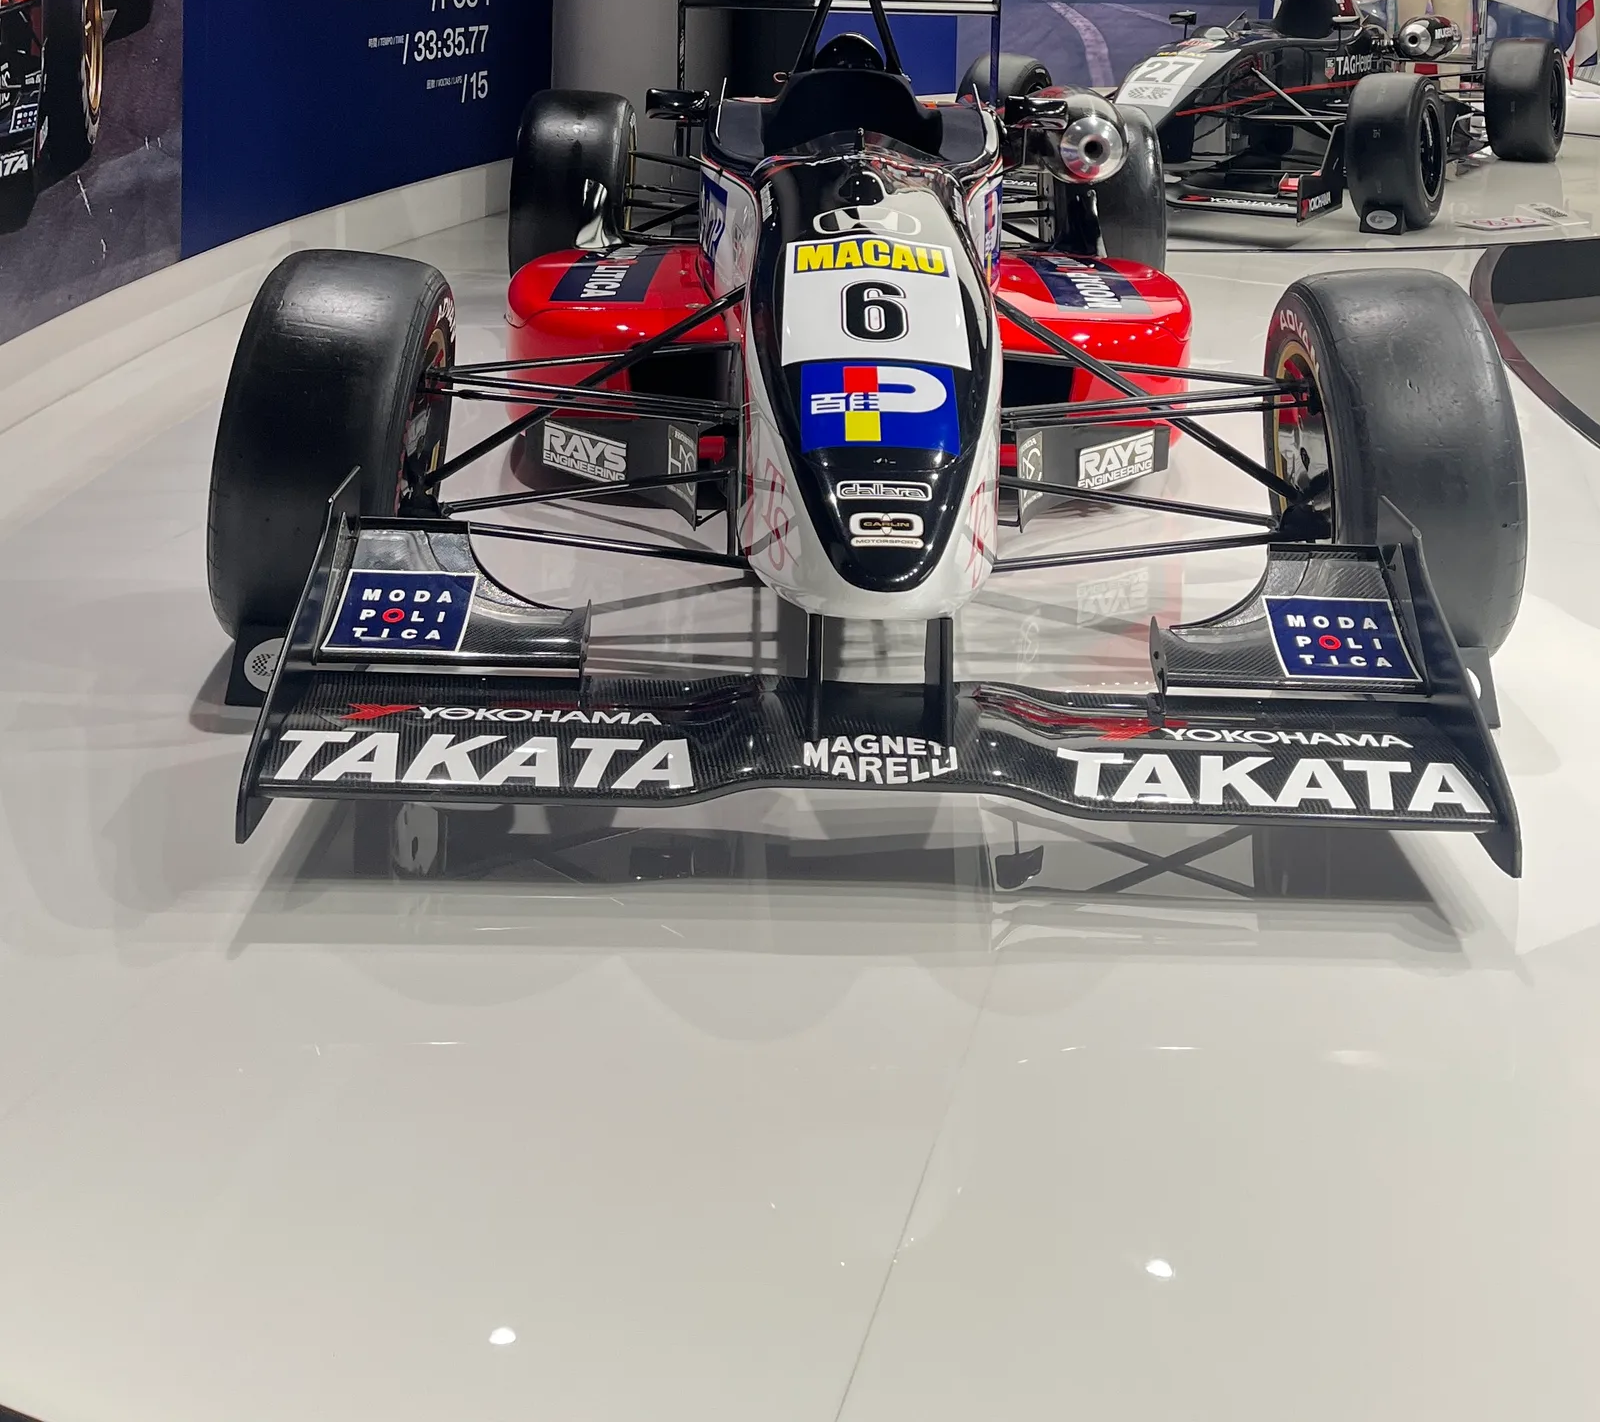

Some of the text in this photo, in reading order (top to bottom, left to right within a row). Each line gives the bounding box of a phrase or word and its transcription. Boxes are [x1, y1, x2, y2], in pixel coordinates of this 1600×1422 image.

[1134, 60, 1195, 83] 27
[1210, 196, 1289, 209] YOKOHAMA
[797, 239, 946, 274] MACAU
[840, 279, 910, 343] 6
[810, 392, 880, 415] 百佳
[544, 426, 627, 472] RAYS
[1079, 435, 1154, 481] RAYS
[543, 449, 626, 482] ENGINEERING
[1077, 462, 1153, 489] ENGINEERING
[841, 483, 927, 499] dallara
[362, 588, 453, 605] MODA
[359, 608, 447, 624] POLI
[1287, 613, 1379, 631] MODA
[353, 627, 442, 642] TICA
[1296, 635, 1382, 651] POLI
[1298, 654, 1393, 669] TICA
[418, 705, 663, 726] YOKOHAMA
[1161, 727, 1414, 749] YOKOHAMA
[273, 729, 695, 789] TAKATA
[1056, 747, 1490, 813] TAKATA
